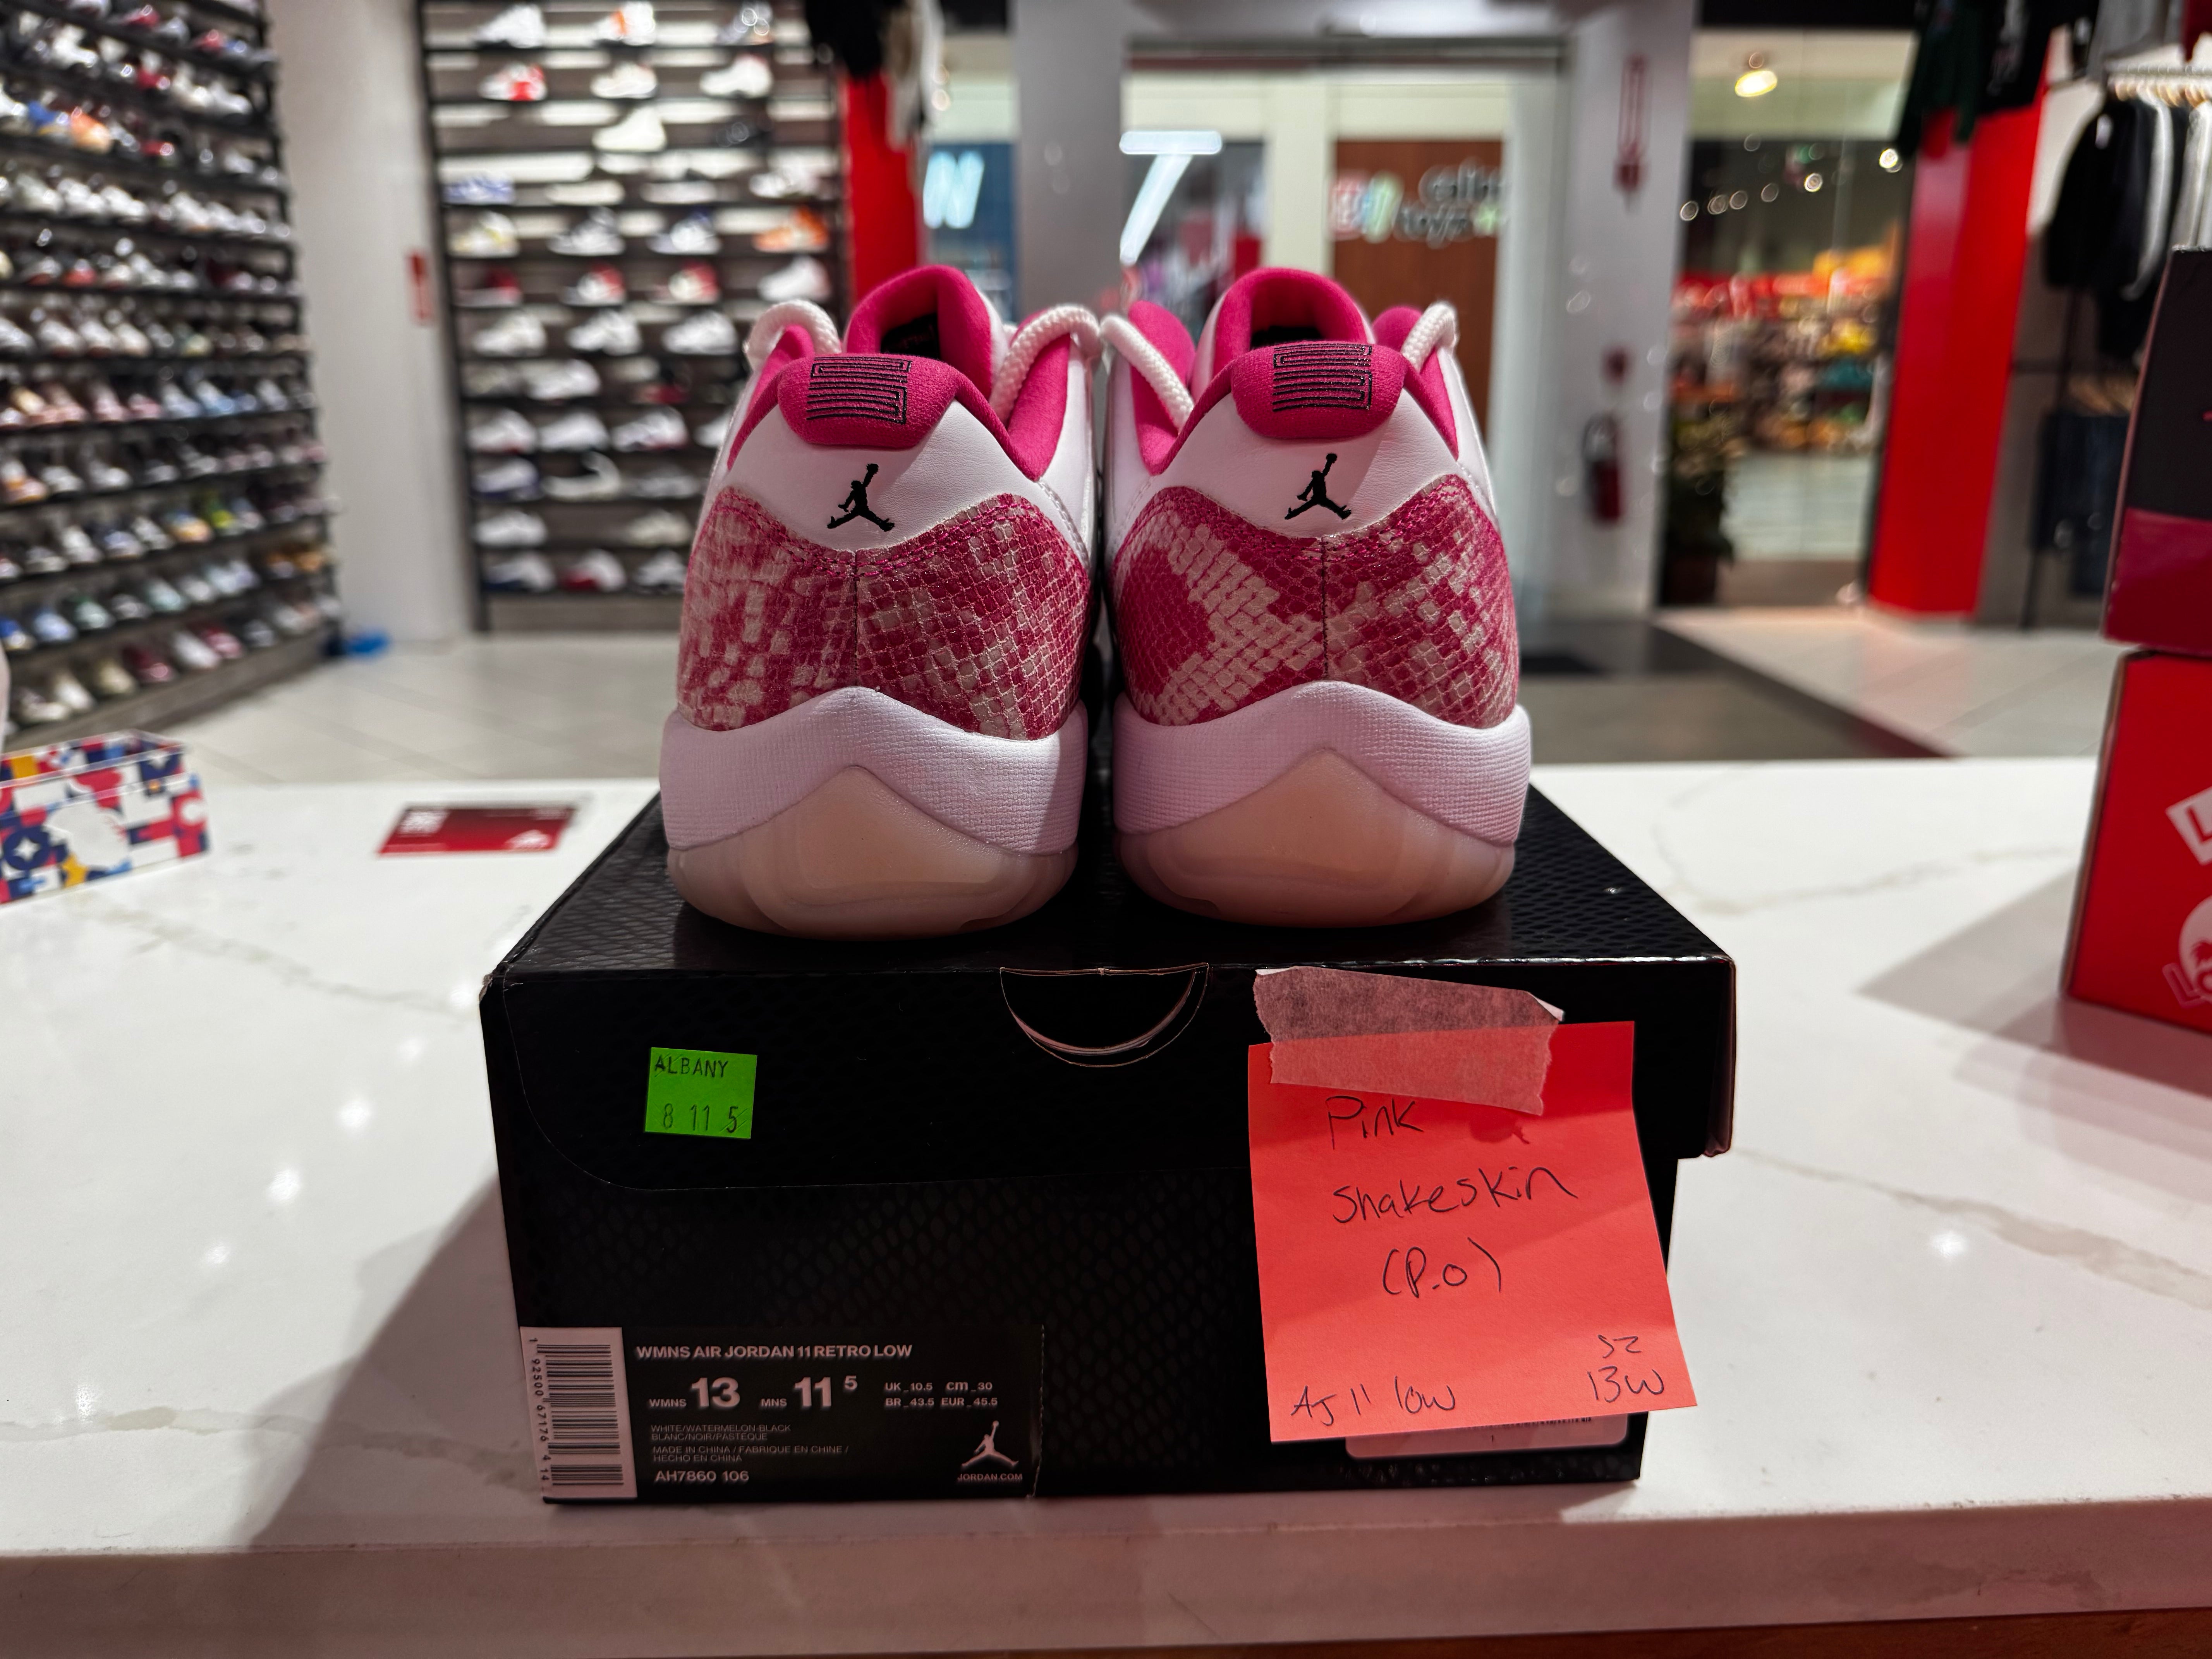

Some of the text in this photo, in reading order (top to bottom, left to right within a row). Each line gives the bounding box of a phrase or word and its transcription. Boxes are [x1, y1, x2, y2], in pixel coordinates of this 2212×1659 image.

[654, 1054, 728, 1078] ALBANY
[663, 1103, 673, 1129] 8
[726, 1106, 738, 1133] 5
[1325, 1095, 1424, 1150] Pink
[636, 1344, 913, 1358] WMNS AIR JORDAN 11 RETRO LOW
[532, 1358, 543, 1396] 92500
[649, 1375, 858, 1408] WMNS 13 MNS 11 5
[1291, 1385, 1336, 1426] AJ
[537, 1405, 549, 1442] 67176
[654, 1454, 691, 1462] HECHO
[693, 1454, 708, 1462] EN
[699, 1446, 731, 1454] CHINA
[739, 1445, 790, 1454] FABRIQUE
[793, 1445, 808, 1453] EN
[811, 1445, 842, 1453] CHINE
[654, 1470, 750, 1483] AH7860 106
[957, 1473, 1023, 1483] JORDAN.COM
